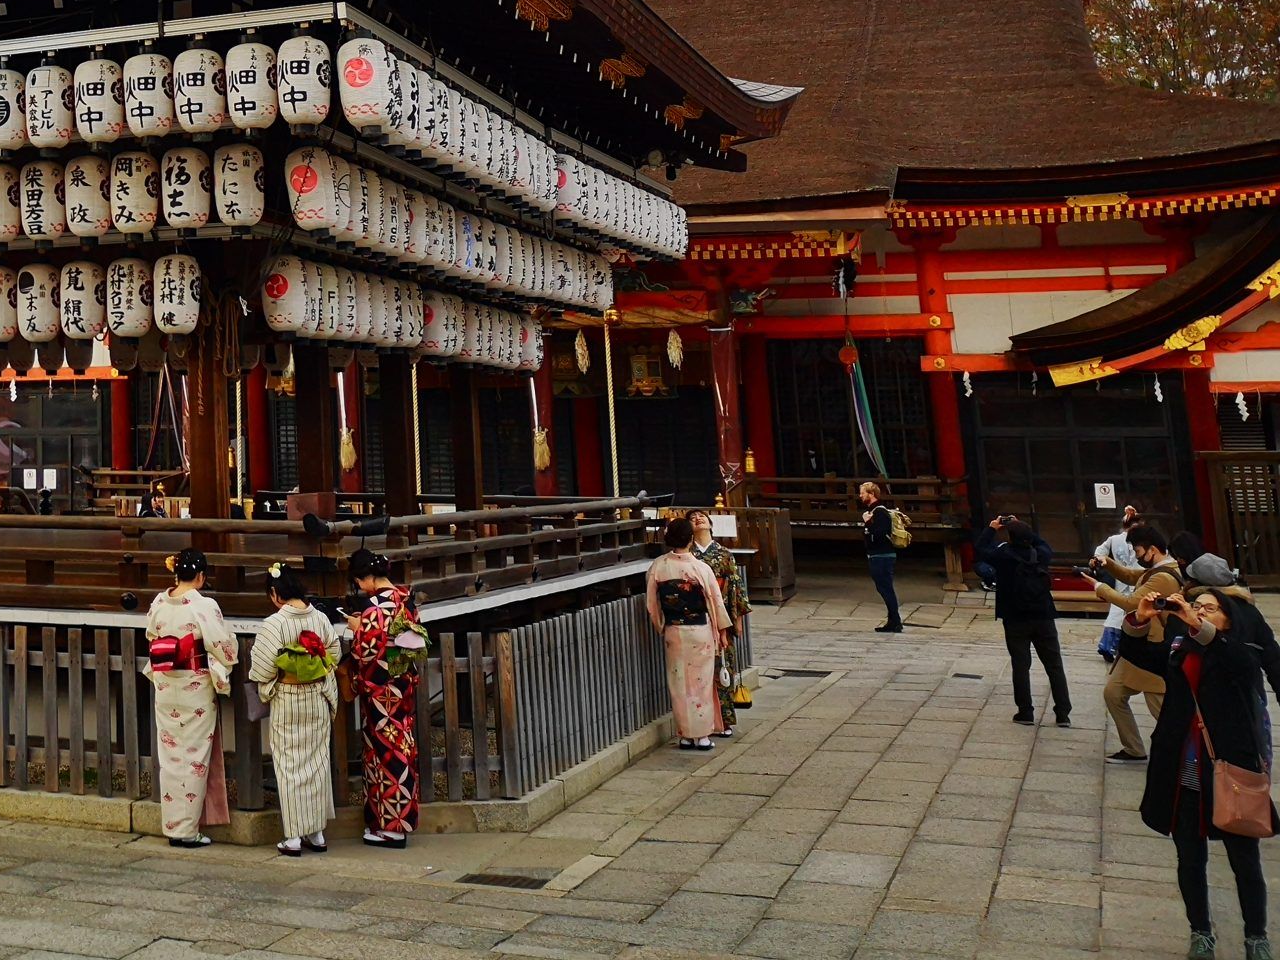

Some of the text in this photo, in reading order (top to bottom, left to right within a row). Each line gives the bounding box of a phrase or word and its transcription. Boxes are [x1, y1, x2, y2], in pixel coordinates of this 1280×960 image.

[39, 89, 55, 130] アービル
[75, 81, 105, 134] 畑中
[126, 76, 157, 128] 畑中
[175, 71, 206, 125] 畑中
[228, 69, 257, 116] 畑中
[278, 59, 311, 114] 畑中
[28, 94, 41, 137] 美容室
[69, 165, 95, 225] 泉政
[115, 157, 137, 224] 岡きみ
[221, 154, 242, 221] たに本
[25, 293, 42, 333] 末友
[111, 264, 127, 331] 北村クリニック
